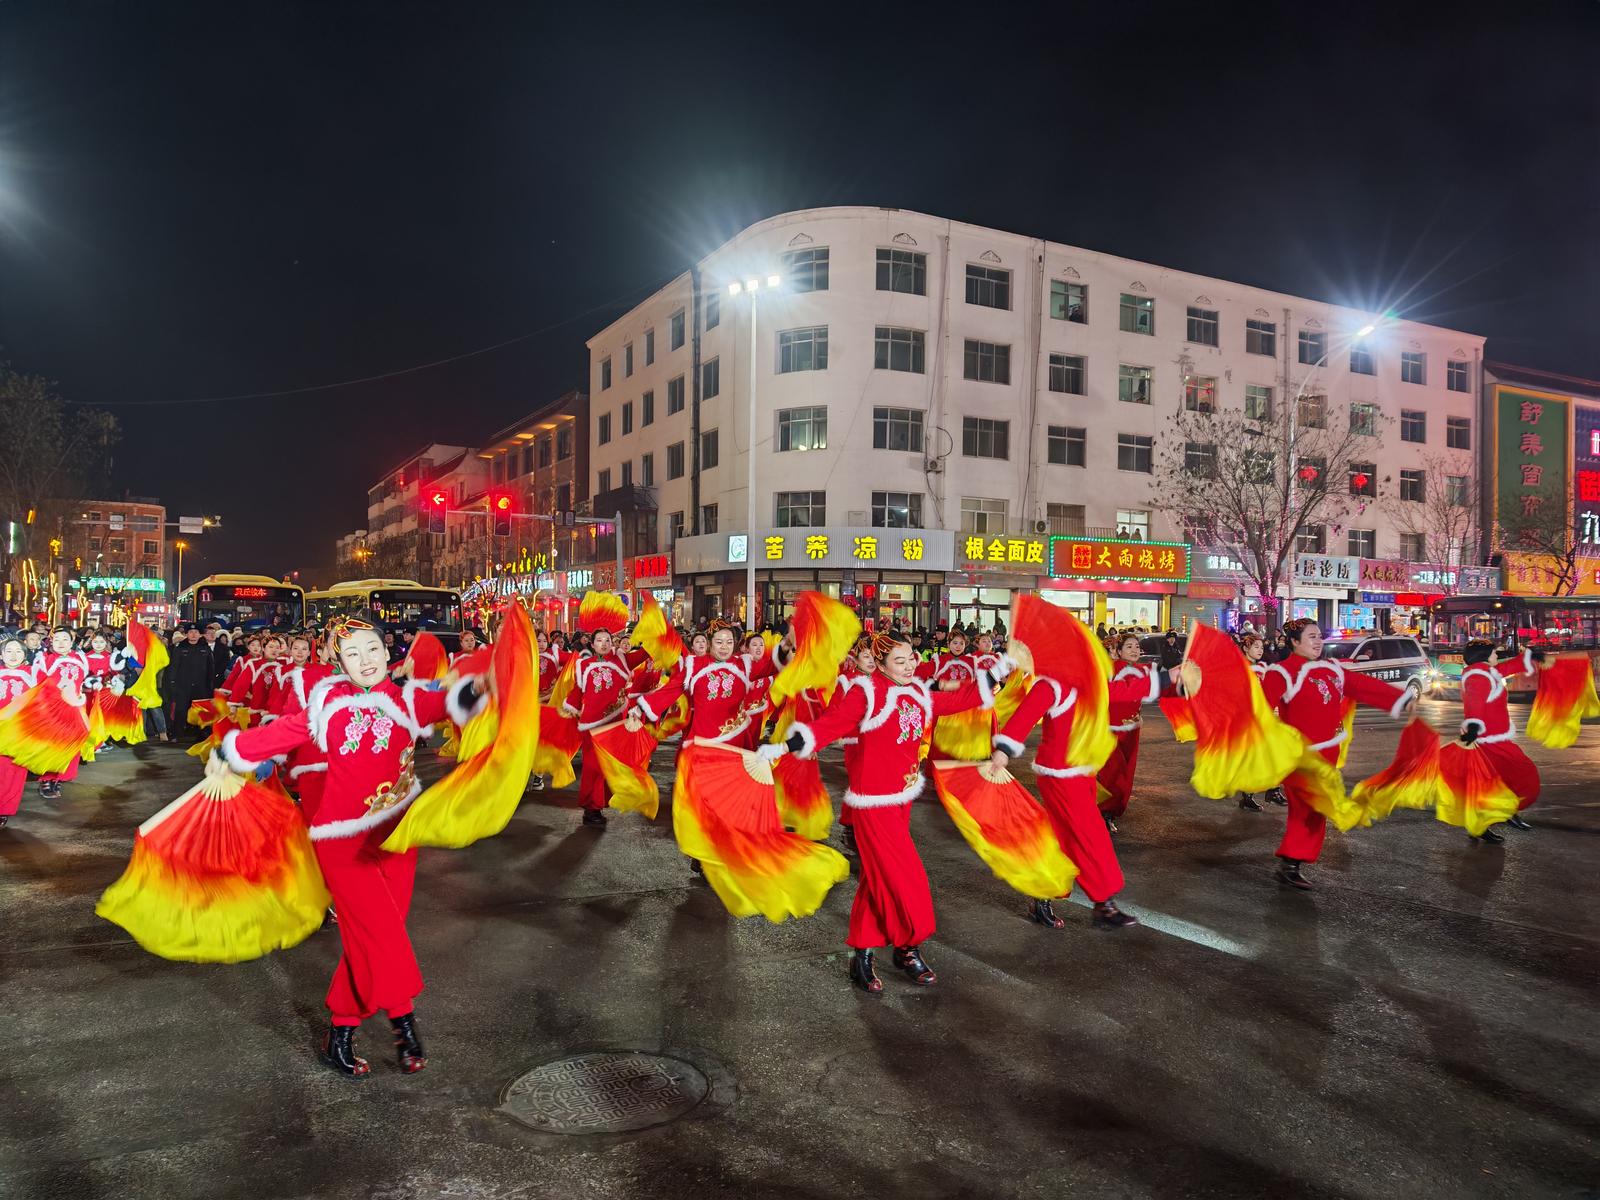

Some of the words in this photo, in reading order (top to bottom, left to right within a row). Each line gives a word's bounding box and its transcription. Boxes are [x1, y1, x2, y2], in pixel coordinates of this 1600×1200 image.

[764, 535, 924, 561] 苦荞凉粉
[965, 536, 1044, 564] 根全面皮
[1096, 546, 1176, 573] 大雨烧烤
[201, 593, 211, 602] 11
[373, 602, 382, 610] 12
